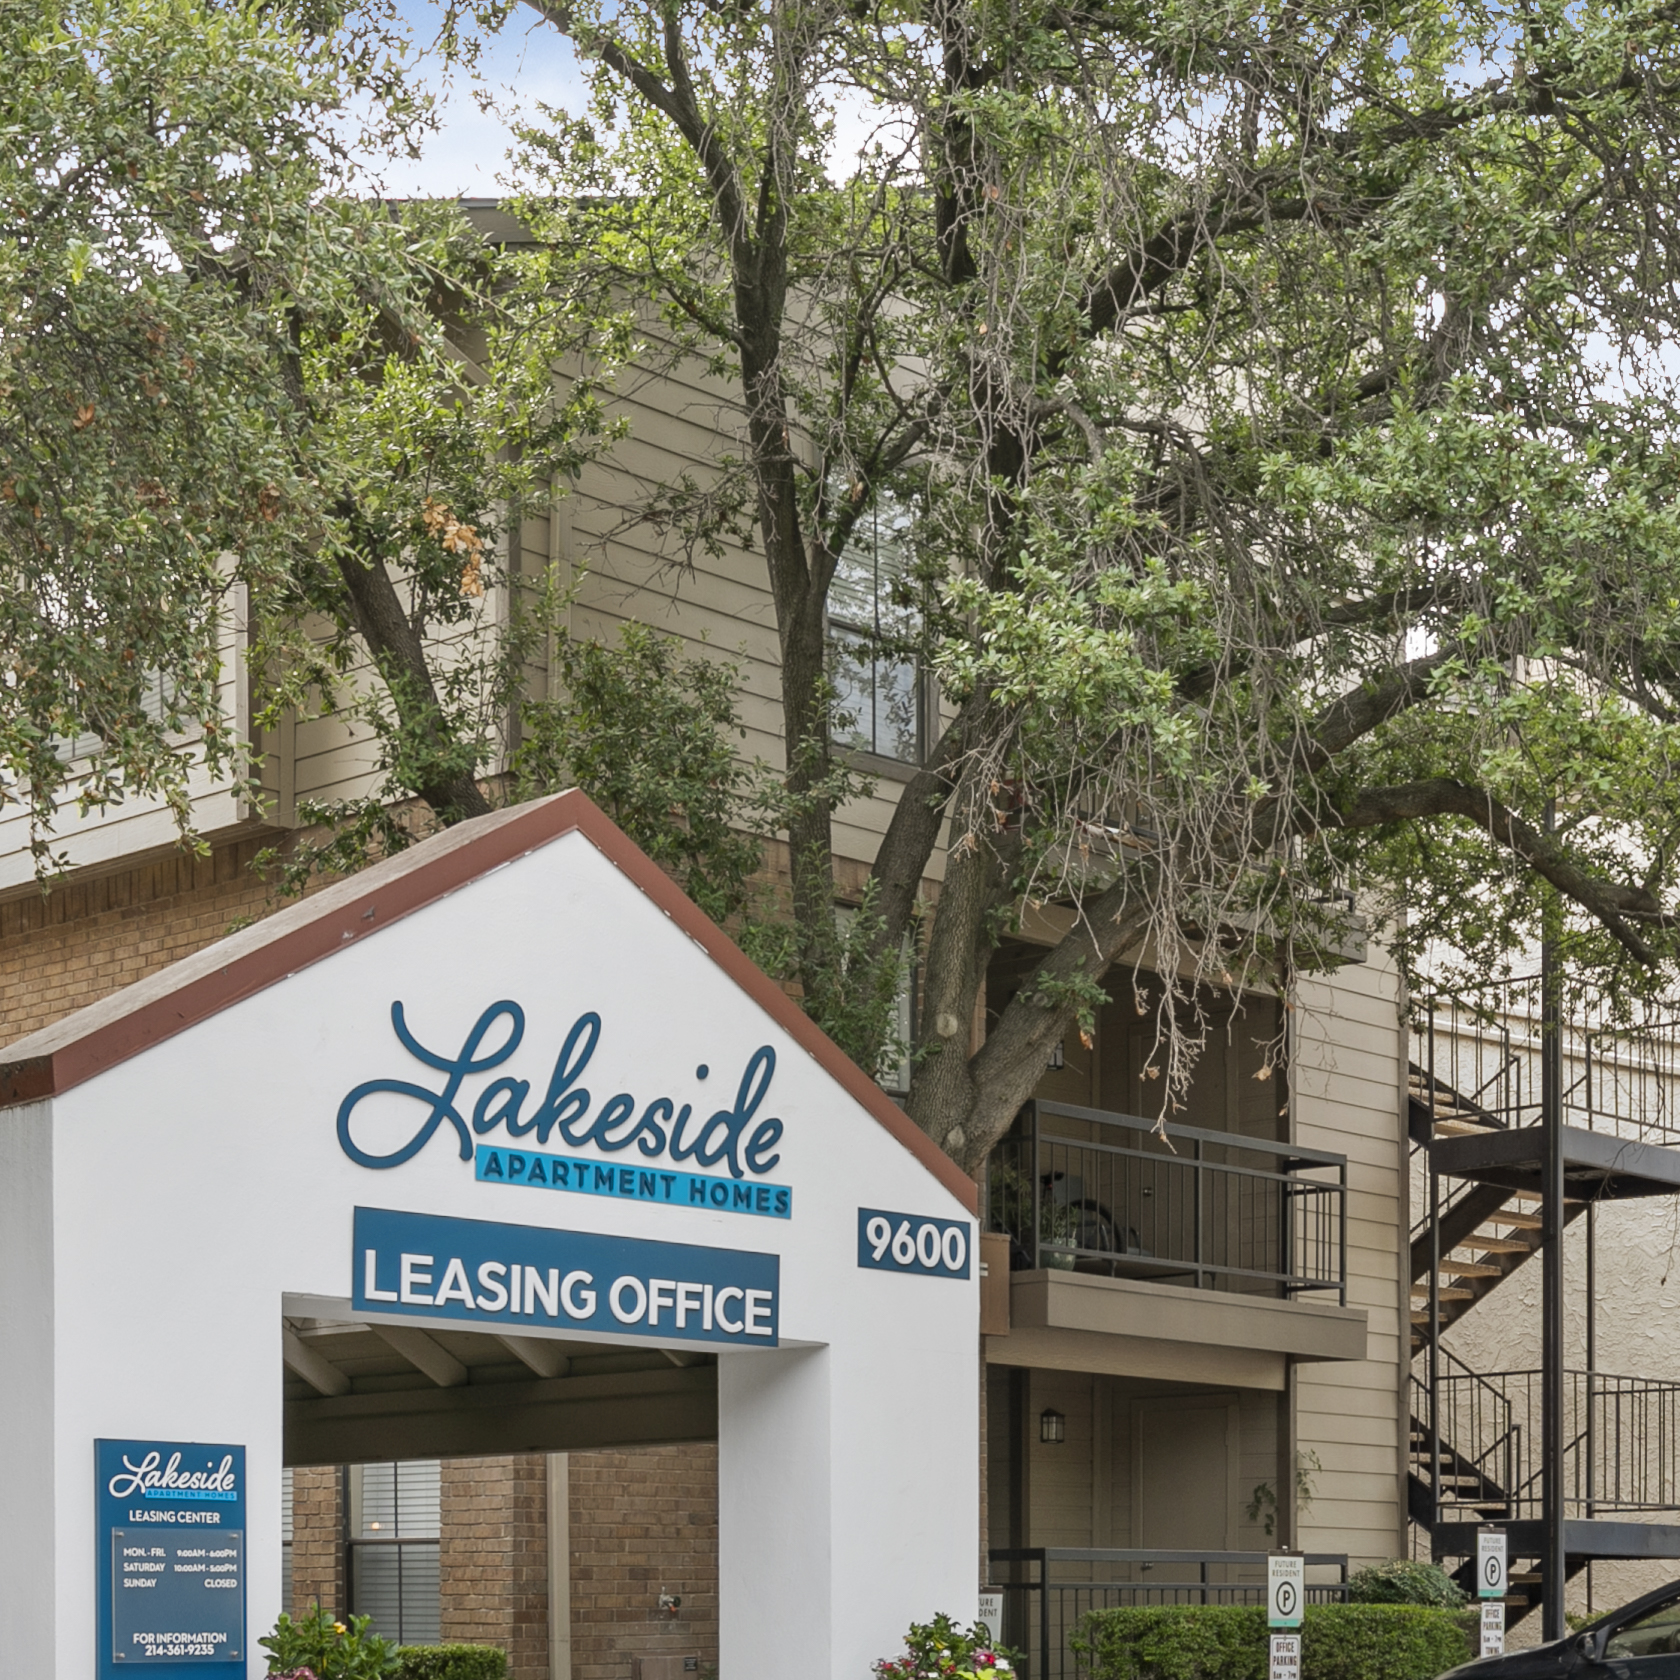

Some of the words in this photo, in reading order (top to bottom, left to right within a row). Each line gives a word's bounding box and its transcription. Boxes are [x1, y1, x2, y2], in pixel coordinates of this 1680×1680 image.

[336, 999, 785, 1179] Lakeside
[482, 1151, 677, 1200] APARTMENT
[689, 1180, 791, 1216] HOMES
[864, 1216, 968, 1272] 9600
[363, 1248, 598, 1321] LEASING
[608, 1274, 774, 1336] OFFICE
[108, 1451, 235, 1498] Lakeside
[146, 1489, 200, 1499] APARTMENT
[205, 1491, 235, 1500] HOMES
[129, 1509, 176, 1523] LEASING
[177, 1510, 221, 1524] CENTER
[123, 1562, 166, 1572] SATURDAY
[1274, 1560, 1297, 1568] FUTURE
[1272, 1569, 1300, 1577] RESIDENT
[123, 1578, 157, 1588] SUNDAY
[204, 1578, 238, 1588] CLOSED
[978, 1598, 994, 1607] URE
[978, 1608, 997, 1617] DENT
[133, 1632, 156, 1644] FOR
[156, 1632, 227, 1644] INFORMATION
[145, 1644, 215, 1656] 214-361-9235
[1276, 1641, 1295, 1653] OFFICE
[1273, 1655, 1297, 1666] PARKING
